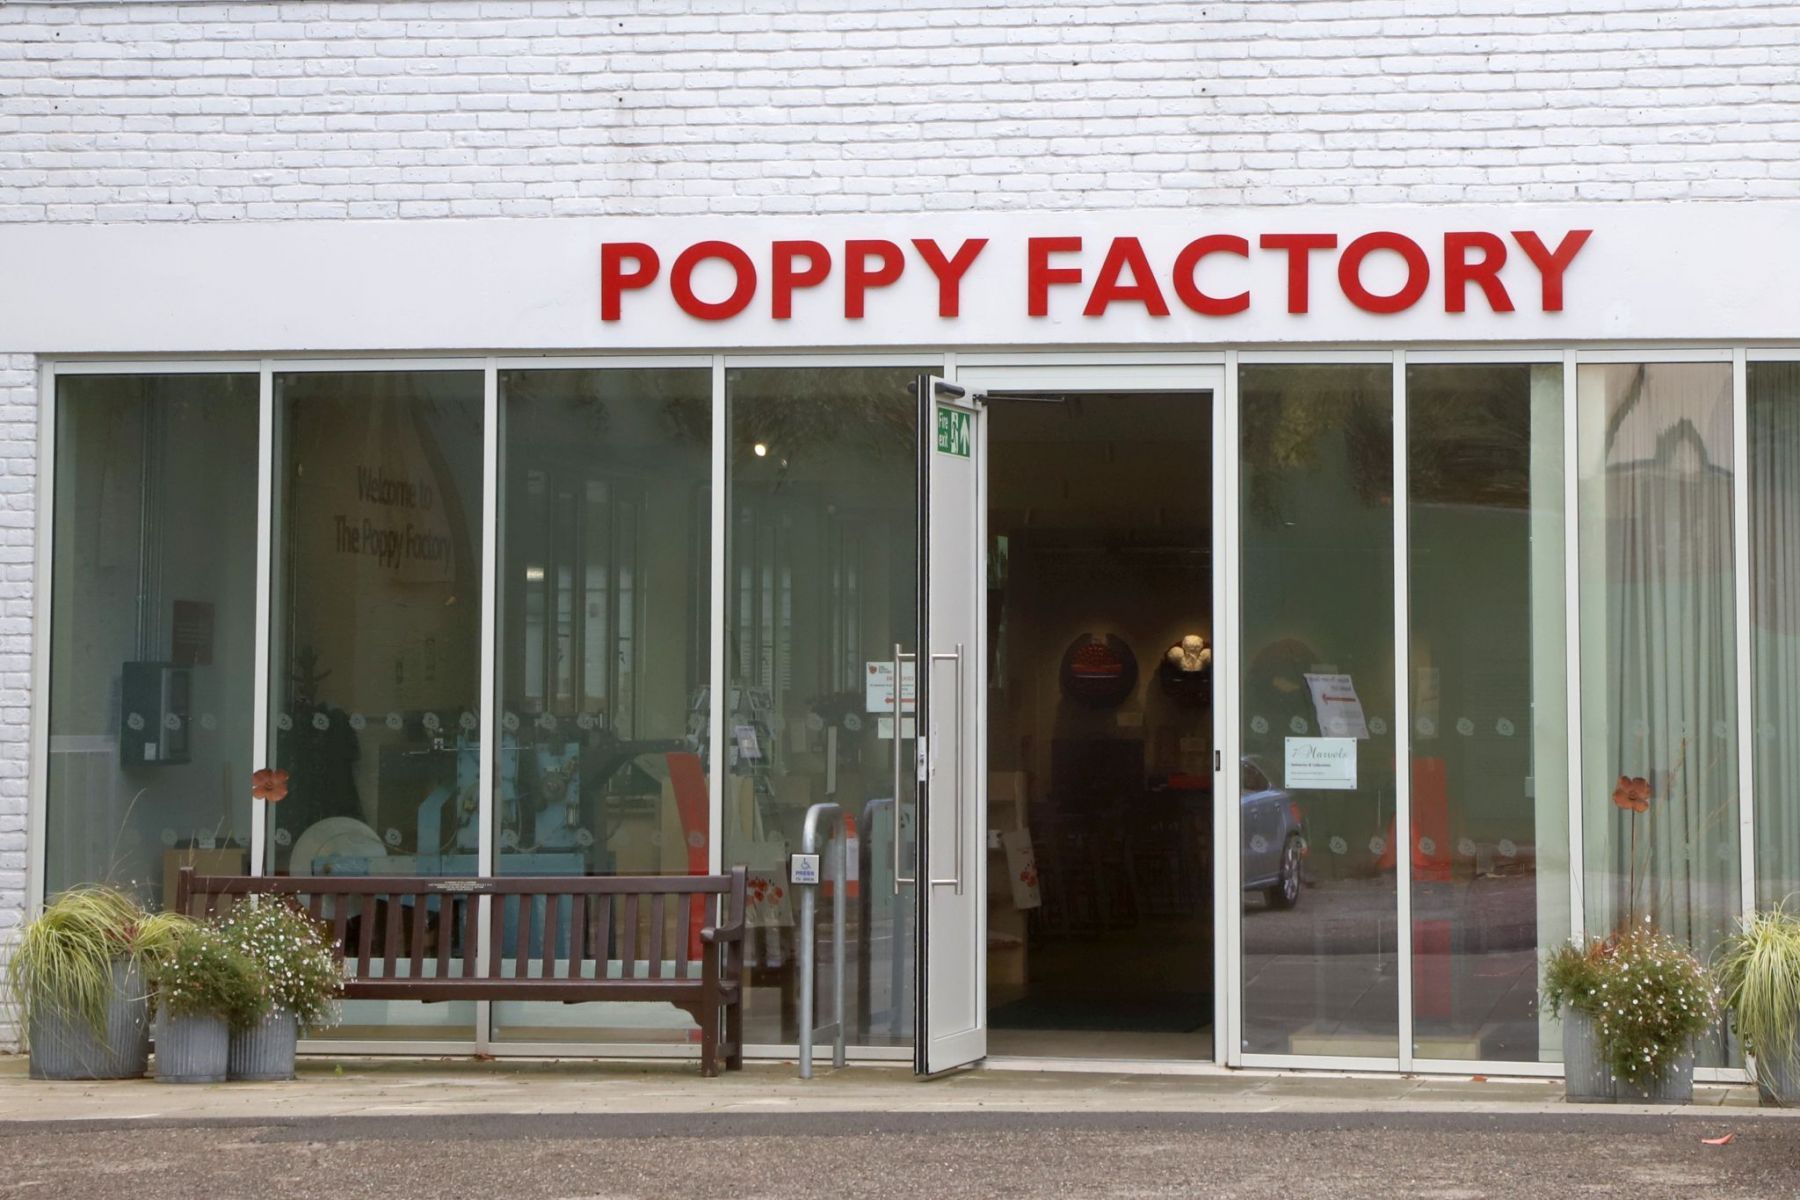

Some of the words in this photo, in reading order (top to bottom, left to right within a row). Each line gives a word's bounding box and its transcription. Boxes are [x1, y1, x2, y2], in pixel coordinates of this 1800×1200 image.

[601, 239, 989, 321] POPPY
[1028, 230, 1593, 316] FACTORY
[356, 465, 417, 508] Welcome
[419, 478, 433, 511] to
[334, 514, 360, 553] The
[362, 518, 404, 570] Poppy
[405, 523, 452, 575] Factory
